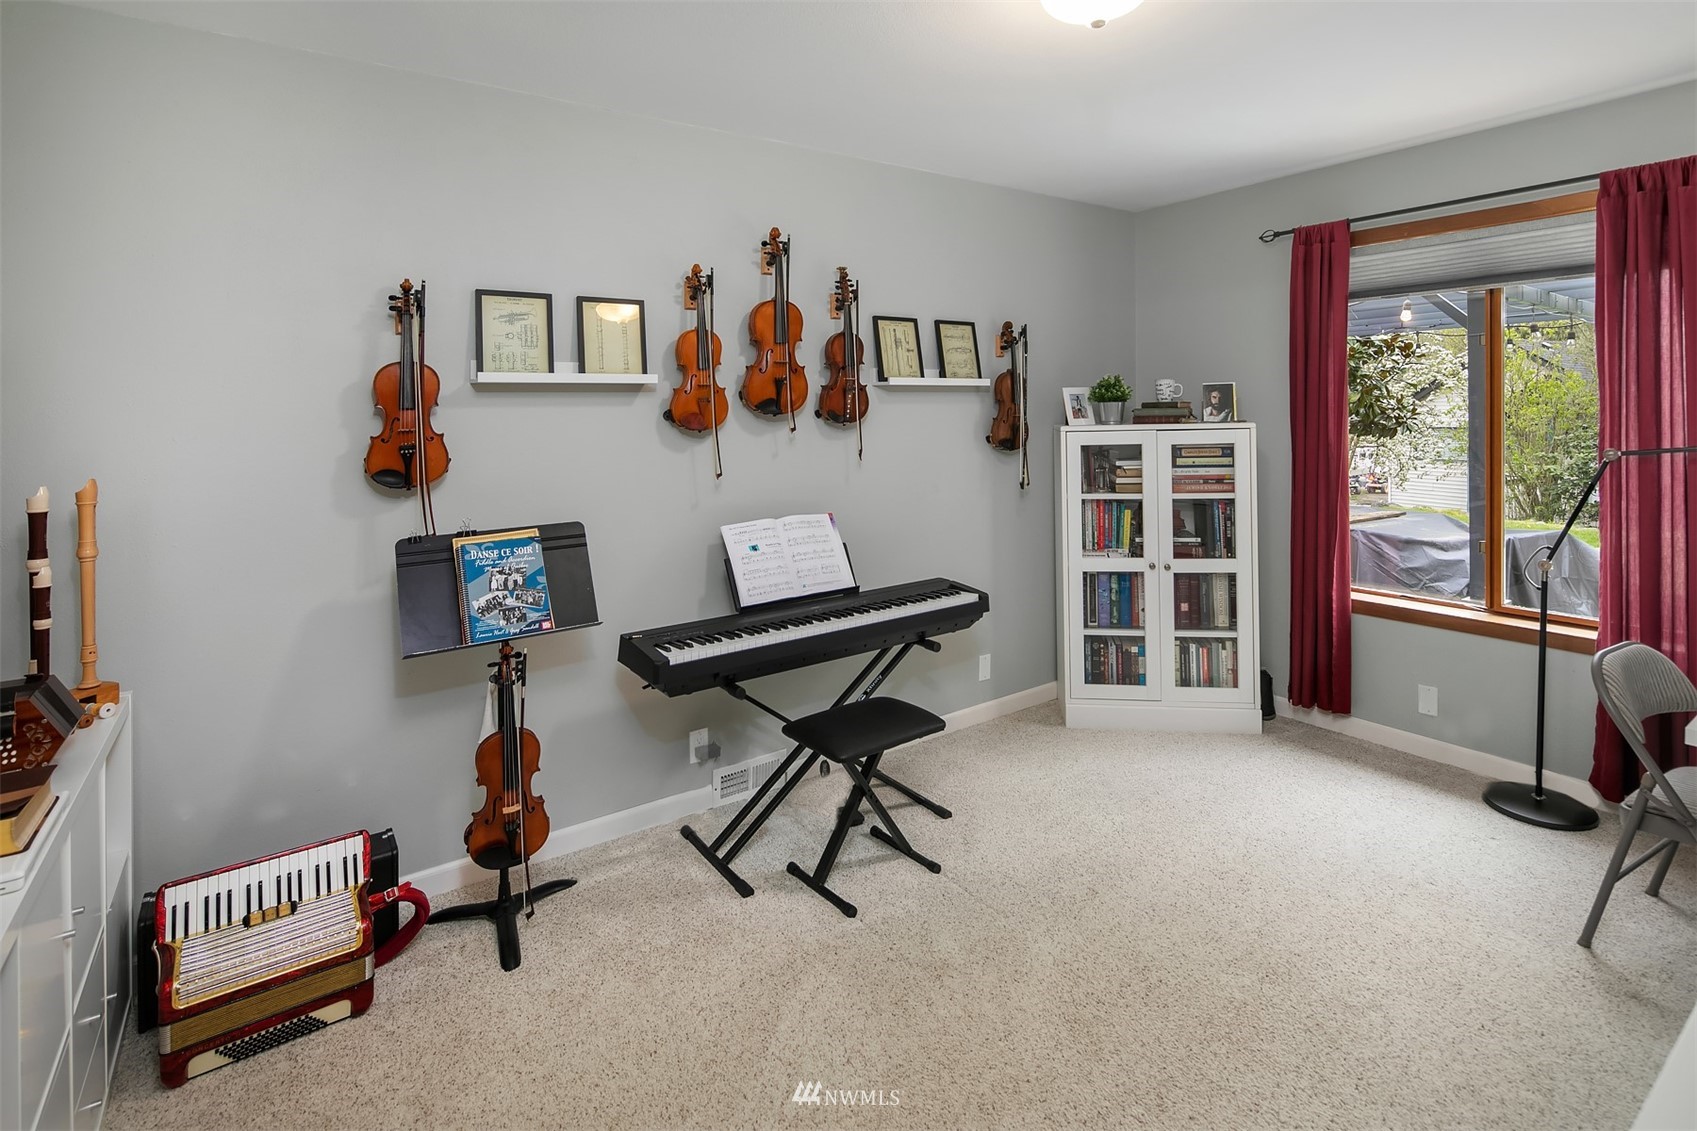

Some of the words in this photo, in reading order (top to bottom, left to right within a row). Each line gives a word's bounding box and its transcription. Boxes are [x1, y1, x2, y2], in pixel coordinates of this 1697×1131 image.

[470, 549, 499, 560] DANSE
[501, 548, 512, 557] CE
[513, 546, 533, 555] SOIR
[494, 556, 507, 565] and
